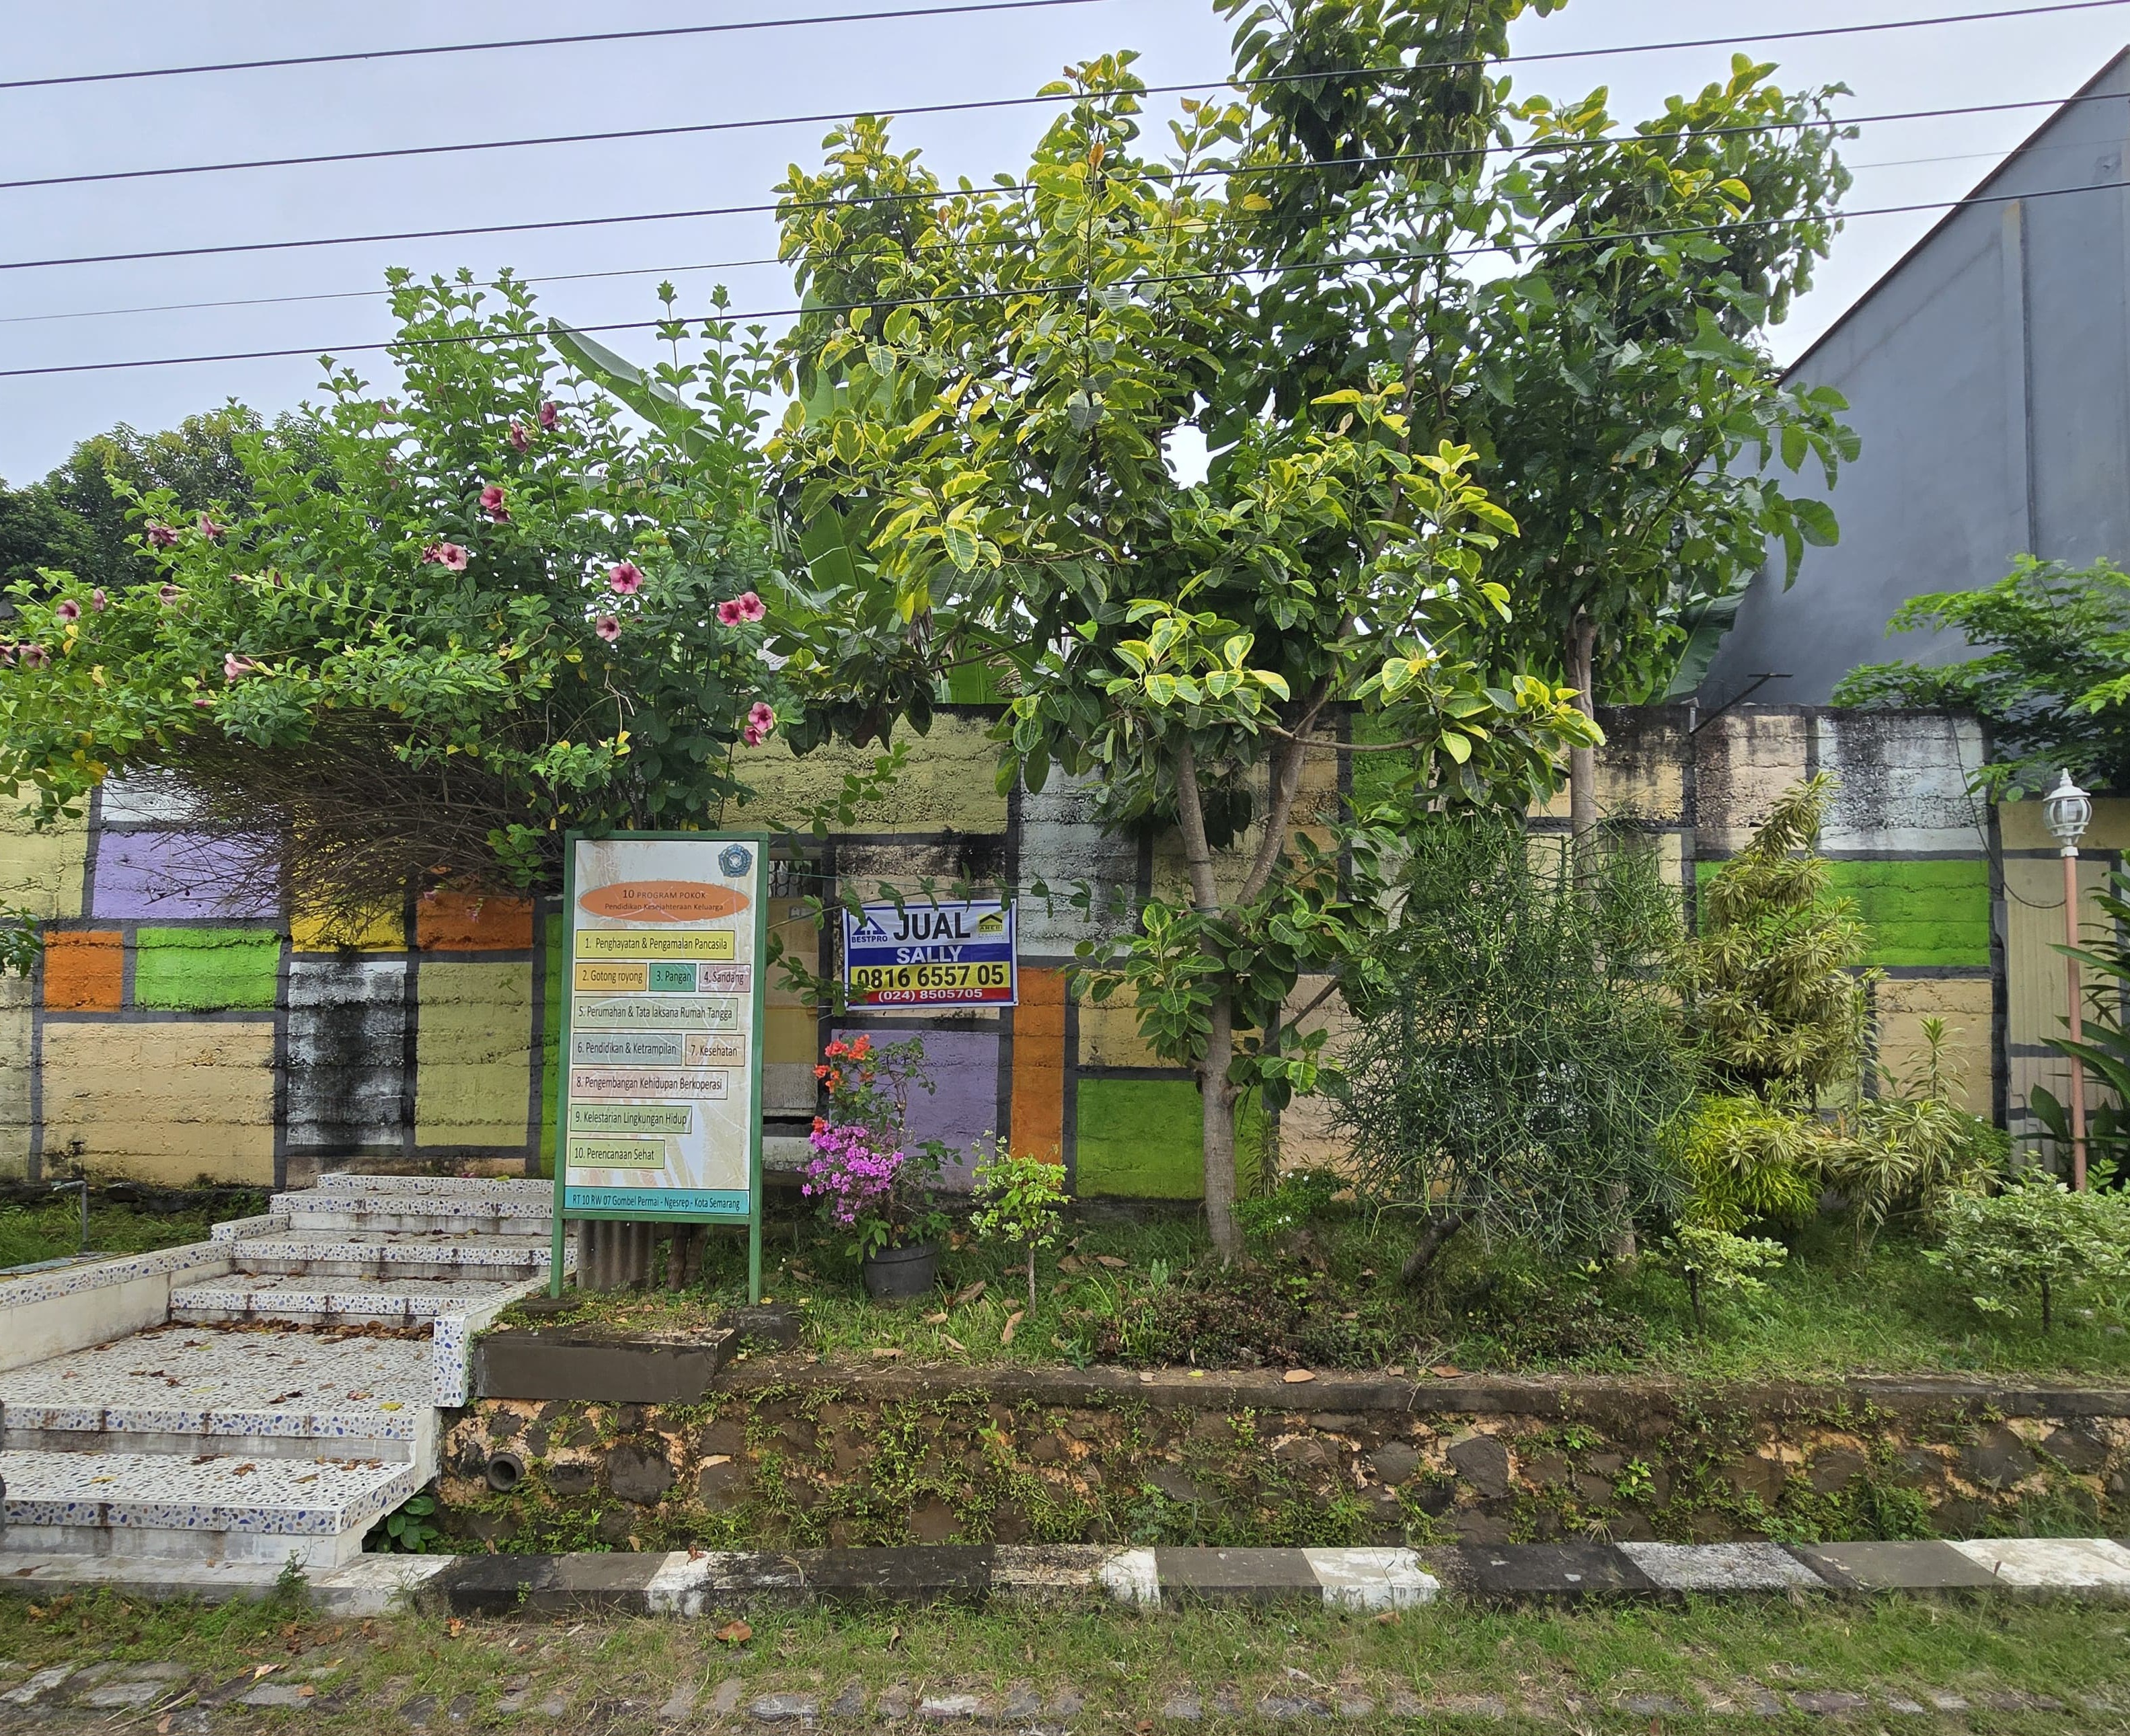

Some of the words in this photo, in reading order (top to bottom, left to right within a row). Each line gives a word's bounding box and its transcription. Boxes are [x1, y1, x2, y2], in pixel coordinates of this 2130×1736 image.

[623, 890, 634, 899] 10
[643, 903, 692, 911] Kesejahteraan
[893, 912, 971, 940] JUAL
[585, 938, 591, 948] 1.
[596, 938, 640, 950] Penghayatan
[642, 939, 648, 948] &
[650, 938, 693, 951] Pengamalan
[695, 938, 728, 949] Pancasila
[851, 935, 888, 943] BESTPRO
[897, 946, 963, 964] SALLY
[582, 971, 589, 981] 2.
[591, 971, 616, 983] Gotong
[618, 973, 643, 983] royong
[656, 971, 663, 981] 3.
[665, 971, 691, 983] Pangan
[703, 971, 711, 982] 4.
[713, 972, 744, 985] Sandang
[857, 967, 910, 988] 0816
[917, 966, 971, 987] 6557
[977, 965, 1003, 985] 05
[878, 991, 915, 1002] (024)
[919, 989, 983, 999] 8505705
[578, 1008, 585, 1017] 5.
[587, 1007, 626, 1018] Perumahan
[628, 1008, 634, 1018] &
[636, 1008, 650, 1018] Tata
[652, 1007, 679, 1018] laksana
[681, 1007, 706, 1018] Rumah
[708, 1008, 732, 1021] Tangga
[578, 1043, 584, 1053] 6.
[586, 1042, 623, 1054] Pendidikan
[625, 1043, 632, 1053] &
[633, 1043, 677, 1056] Ketrampilan
[691, 1045, 698, 1056] 7.
[699, 1045, 737, 1056] Kesehatan
[576, 1077, 583, 1088] 8.
[585, 1077, 638, 1090] Pengembangan
[640, 1078, 678, 1092] Kehidupan
[679, 1078, 722, 1092] Berkoperasi
[576, 1112, 582, 1122] 9.
[584, 1111, 622, 1123] Kelestarian
[623, 1112, 664, 1126] Lingkungan
[665, 1113, 687, 1126] Hidup
[574, 1149, 585, 1159] 10.
[587, 1149, 632, 1160] Perencanaan
[634, 1150, 654, 1160] Sehat
[572, 1195, 581, 1205] RT
[582, 1195, 590, 1205] 10
[591, 1196, 602, 1205] RW
[603, 1196, 611, 1205] 07
[613, 1196, 636, 1206] Gombel
[638, 1196, 659, 1207] Permai
[664, 1199, 689, 1209] Ngesrep
[694, 1198, 708, 1207] Kota
[710, 1199, 740, 1210] Semarang
